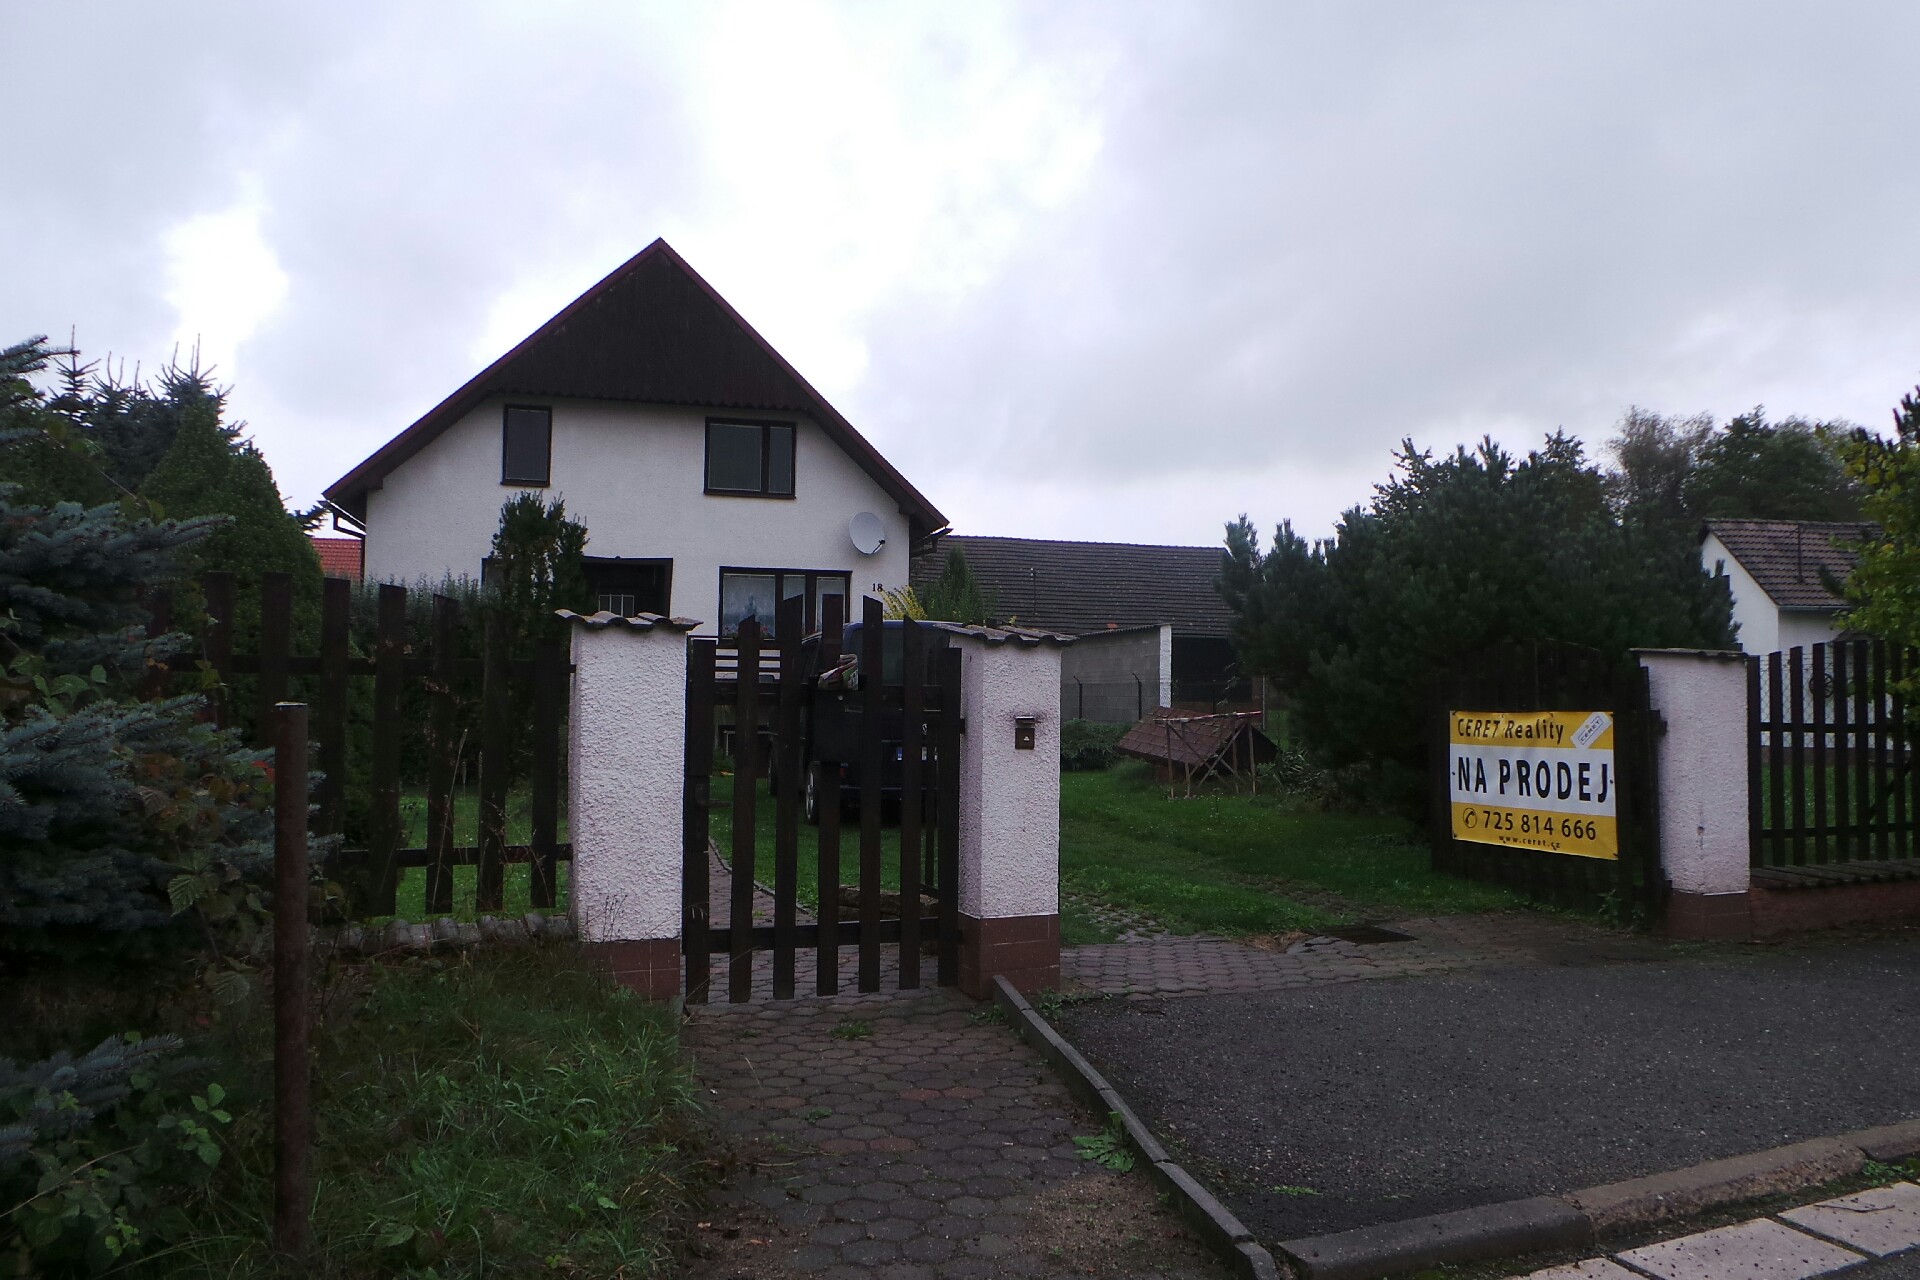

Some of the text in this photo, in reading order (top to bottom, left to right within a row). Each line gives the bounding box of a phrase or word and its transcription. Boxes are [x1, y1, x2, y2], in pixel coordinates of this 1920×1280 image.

[872, 582, 883, 592] 18
[1457, 718, 1564, 745] CERET Reality
[1458, 756, 1608, 803] NA PRODEJ
[1482, 810, 1596, 841] 725 814 666
[1498, 835, 1561, 849] www.ceret.cz
